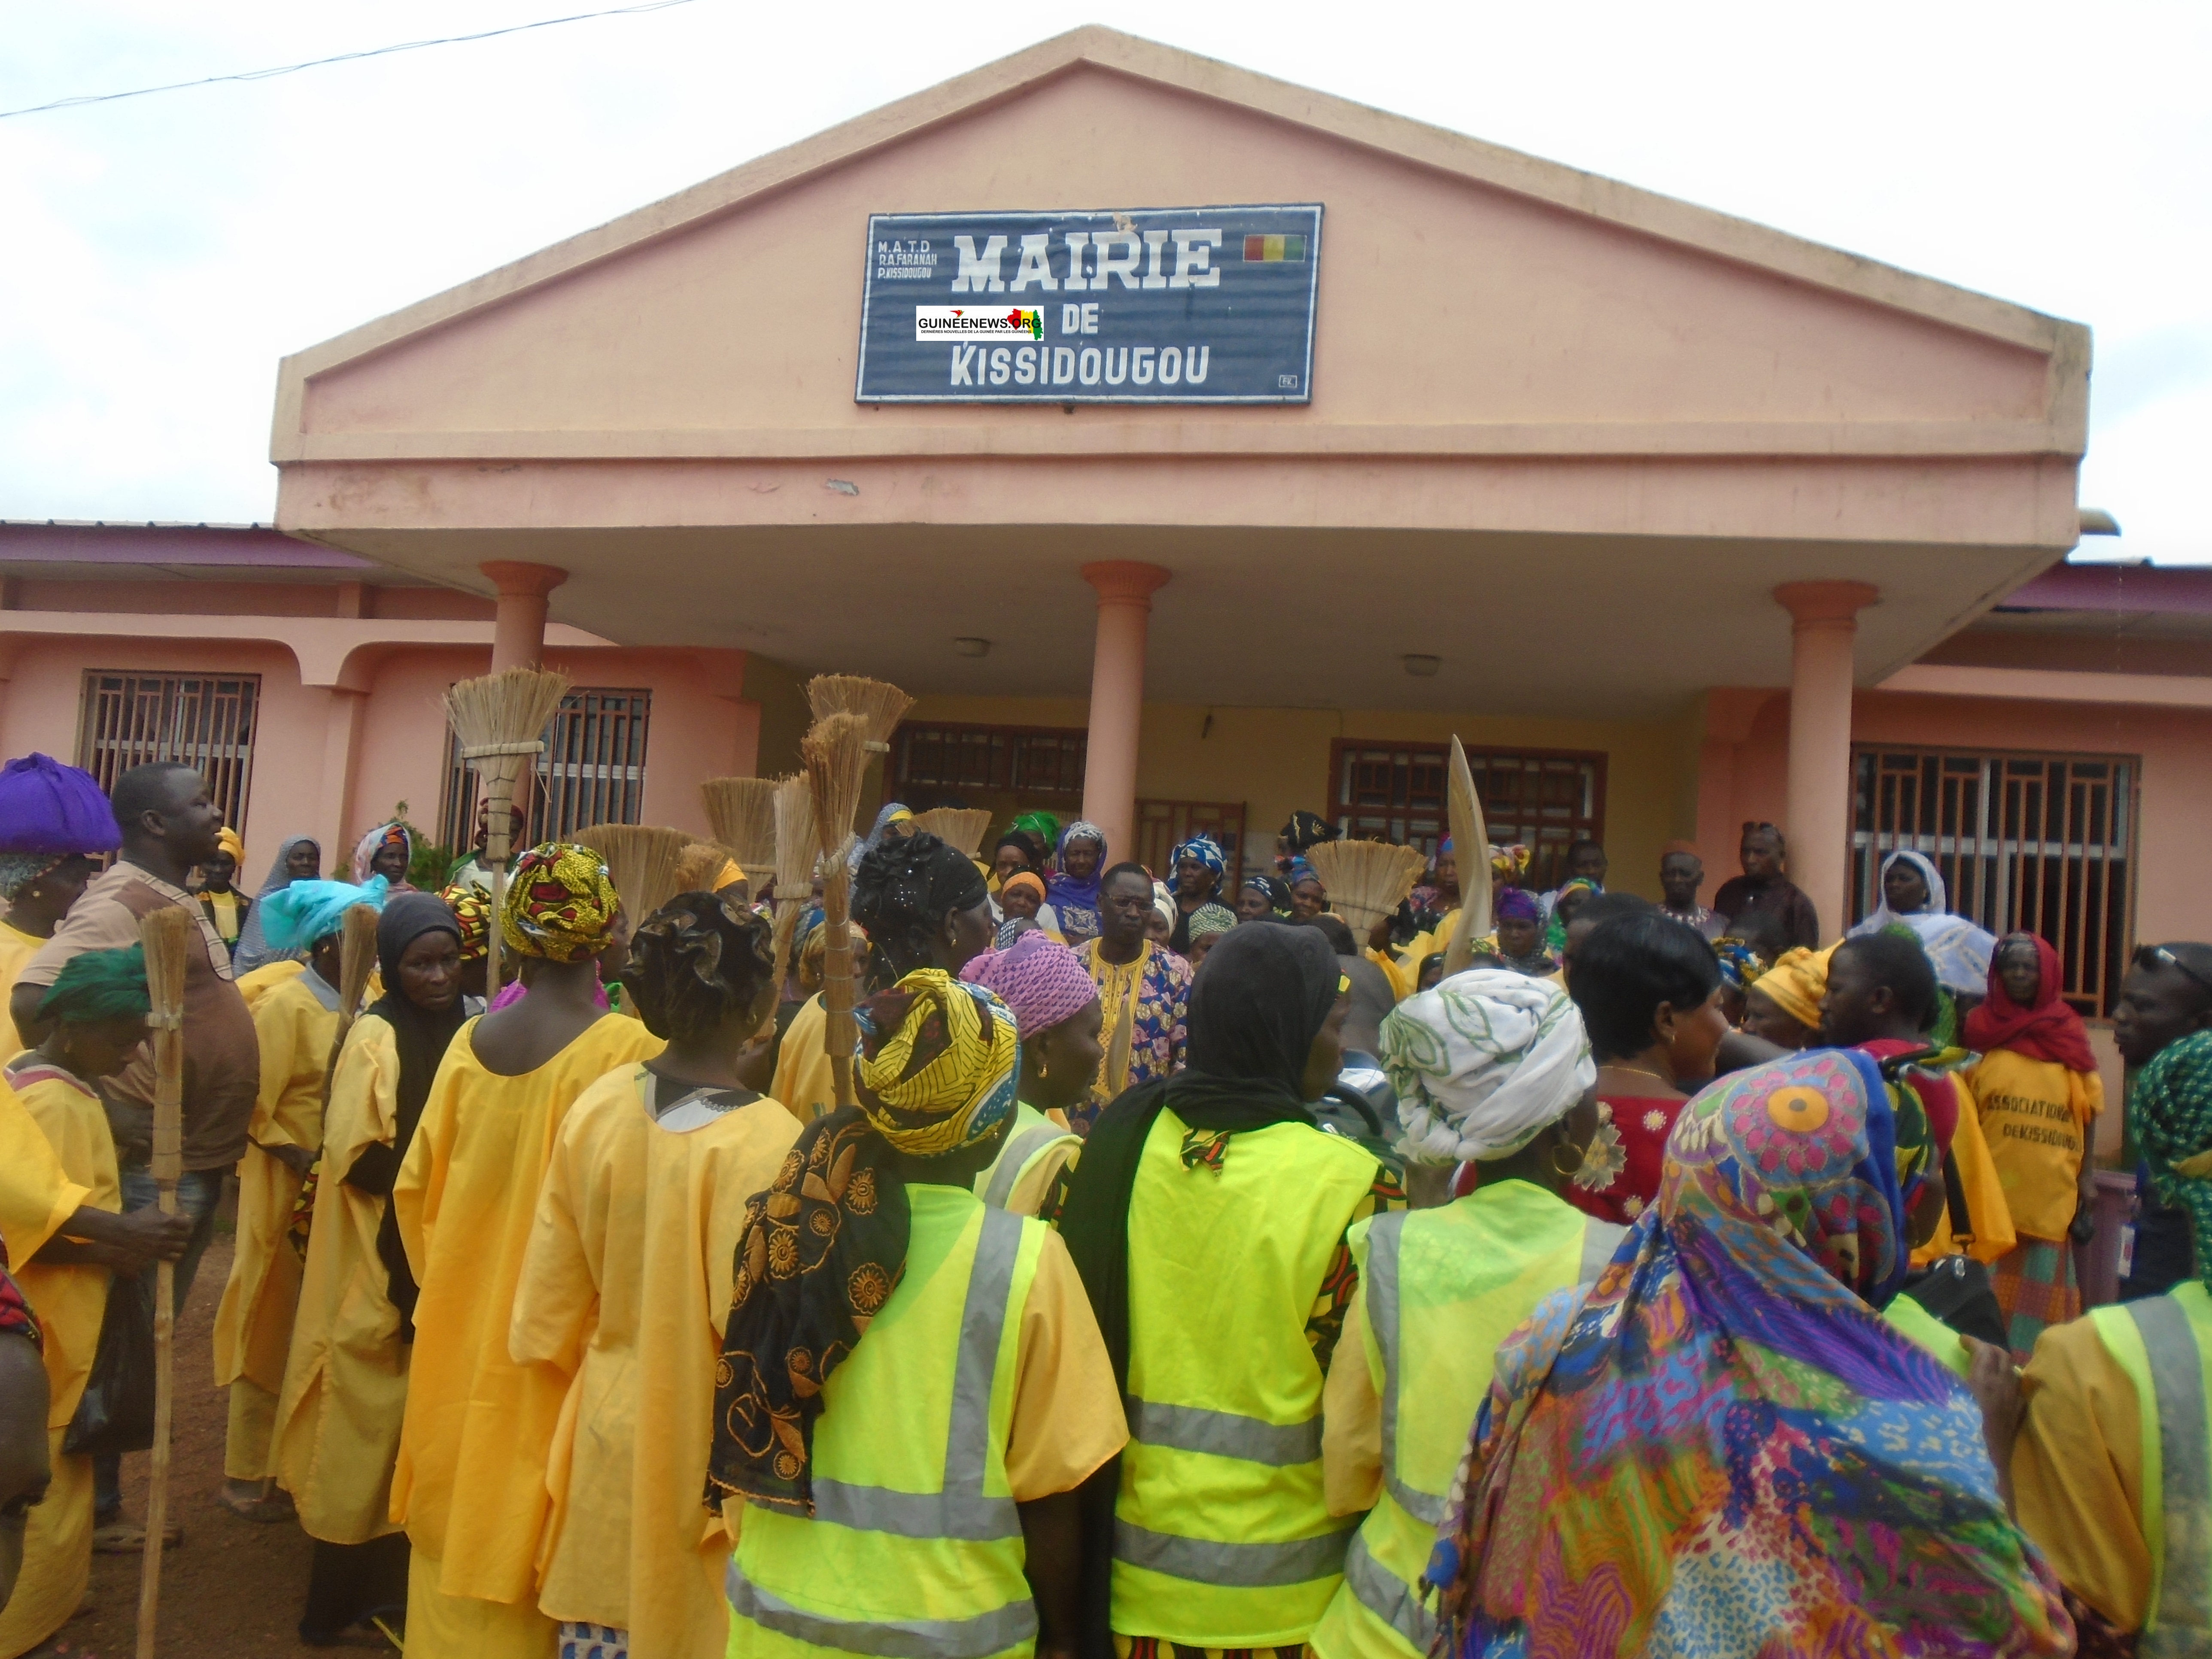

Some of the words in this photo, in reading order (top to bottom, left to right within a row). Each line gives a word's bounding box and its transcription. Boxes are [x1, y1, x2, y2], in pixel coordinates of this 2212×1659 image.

[951, 228, 1222, 292] MAIRIE
[1062, 303, 1099, 335] DE
[951, 345, 1209, 386] KISSIDOUGOU
